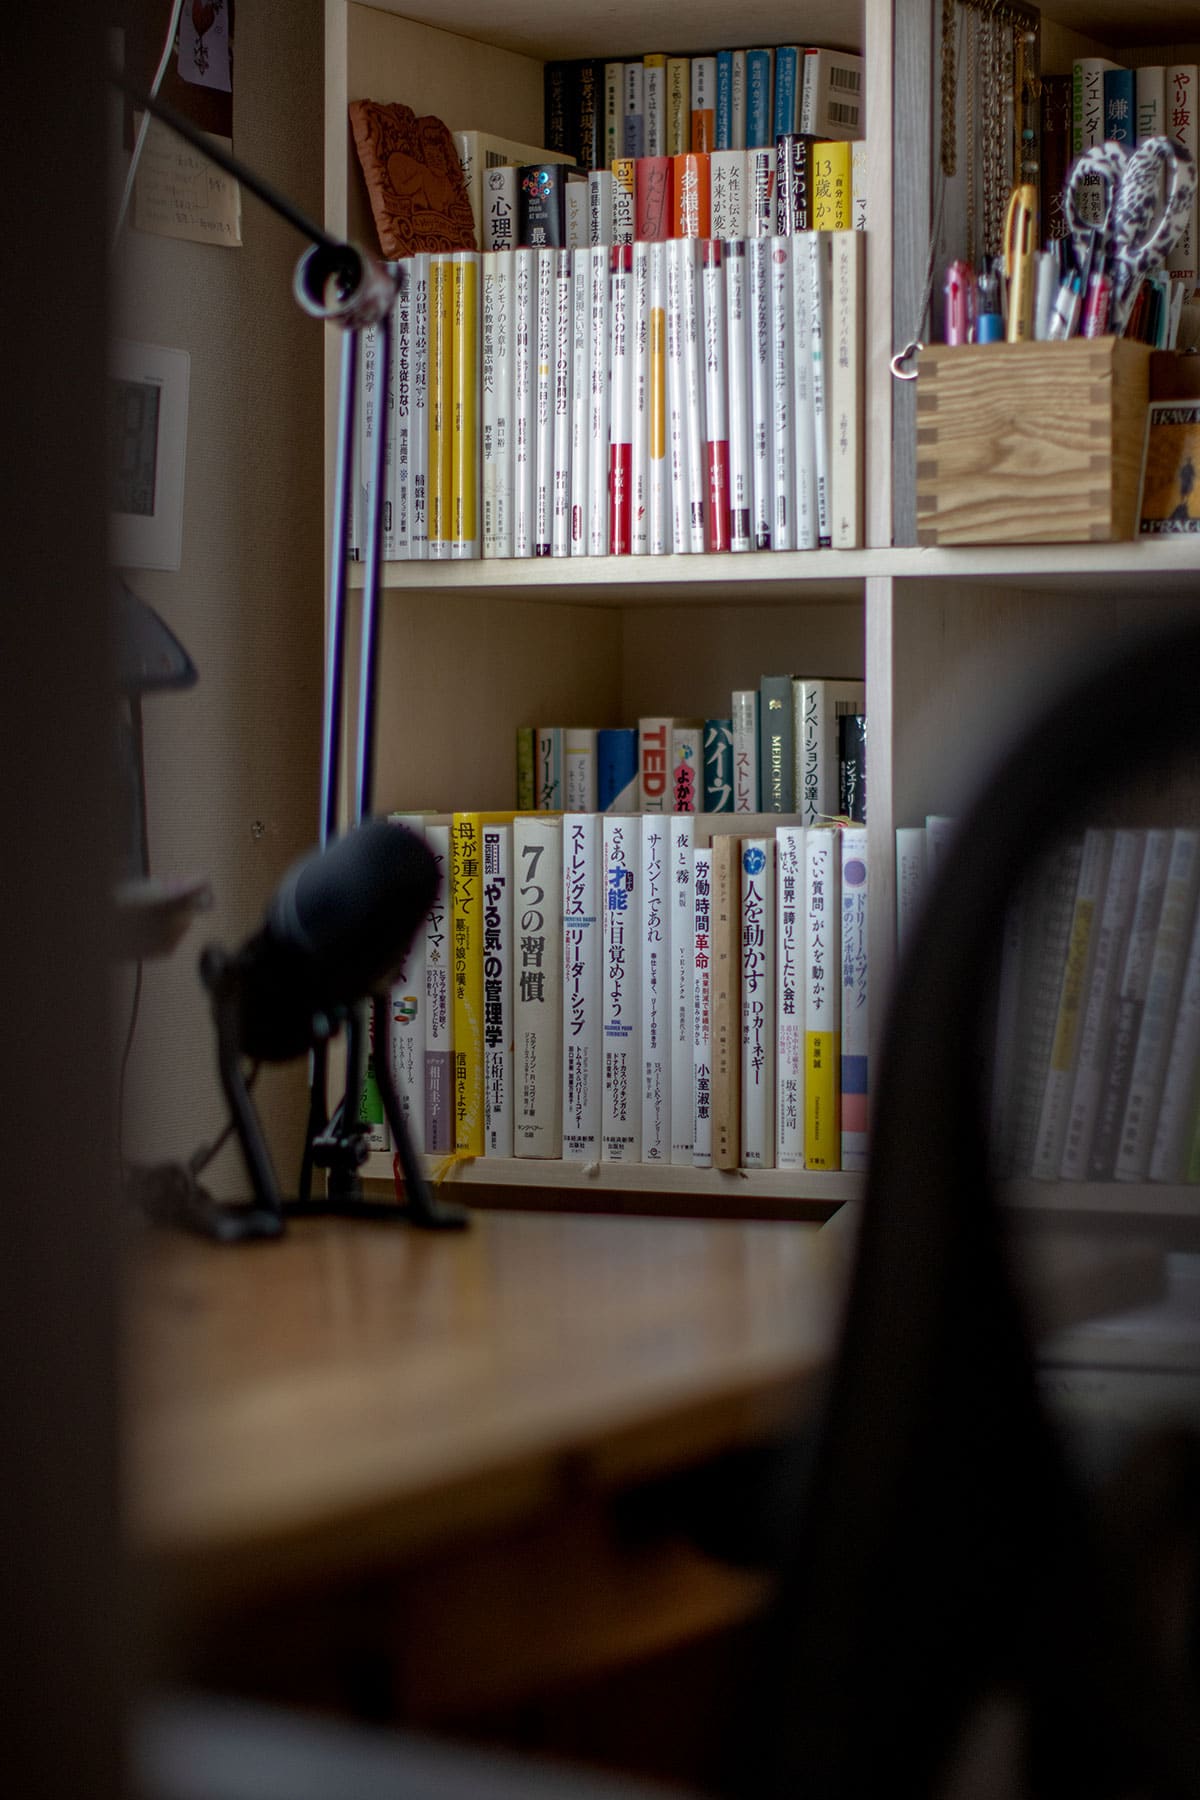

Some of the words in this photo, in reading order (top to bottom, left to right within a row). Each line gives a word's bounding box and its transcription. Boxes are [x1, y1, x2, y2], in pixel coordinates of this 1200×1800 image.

[1085, 72, 1100, 146] ジェンダー
[1139, 100, 1157, 137] Thi
[1172, 73, 1190, 144] やり抜く
[618, 162, 633, 187] Fail
[680, 170, 699, 239] 多様性
[791, 142, 808, 232] 手ごわい問
[491, 196, 512, 250] 心理的
[531, 227, 547, 250] 最
[590, 181, 599, 246] 言語を生み
[415, 280, 427, 409] 君の思いは必ず実現する
[484, 274, 494, 394] 子どもが教育を選ぶ時代へ
[542, 738, 557, 811] リーダ
[642, 725, 666, 797] TED
[676, 769, 691, 811] よかれ
[736, 752, 750, 812] ストレス
[771, 736, 782, 800] MEDICINE
[805, 691, 819, 828] イノベーションの達人!
[846, 760, 857, 821] ジェフリー
[458, 822, 479, 914] 母が重くて
[572, 825, 586, 915] ストレングス
[647, 833, 663, 943] サーバントであれ
[676, 833, 690, 884] 夜と霧
[520, 845, 546, 1003] 7つの習慣
[608, 828, 628, 1018] さあ、才能に目覚めよう
[695, 861, 710, 969] 労働時間革命
[743, 881, 764, 993] 人を動かす
[783, 876, 795, 1014] 世界一誇りにしたい会社
[809, 850, 828, 1010] 「いい質問」が人を動かす
[571, 929, 586, 1036] リーダーシップ
[456, 1052, 467, 1121] 信田さよ子
[698, 1063, 710, 1119] 小室淑恵
[786, 1080, 797, 1130] 坂本光司
